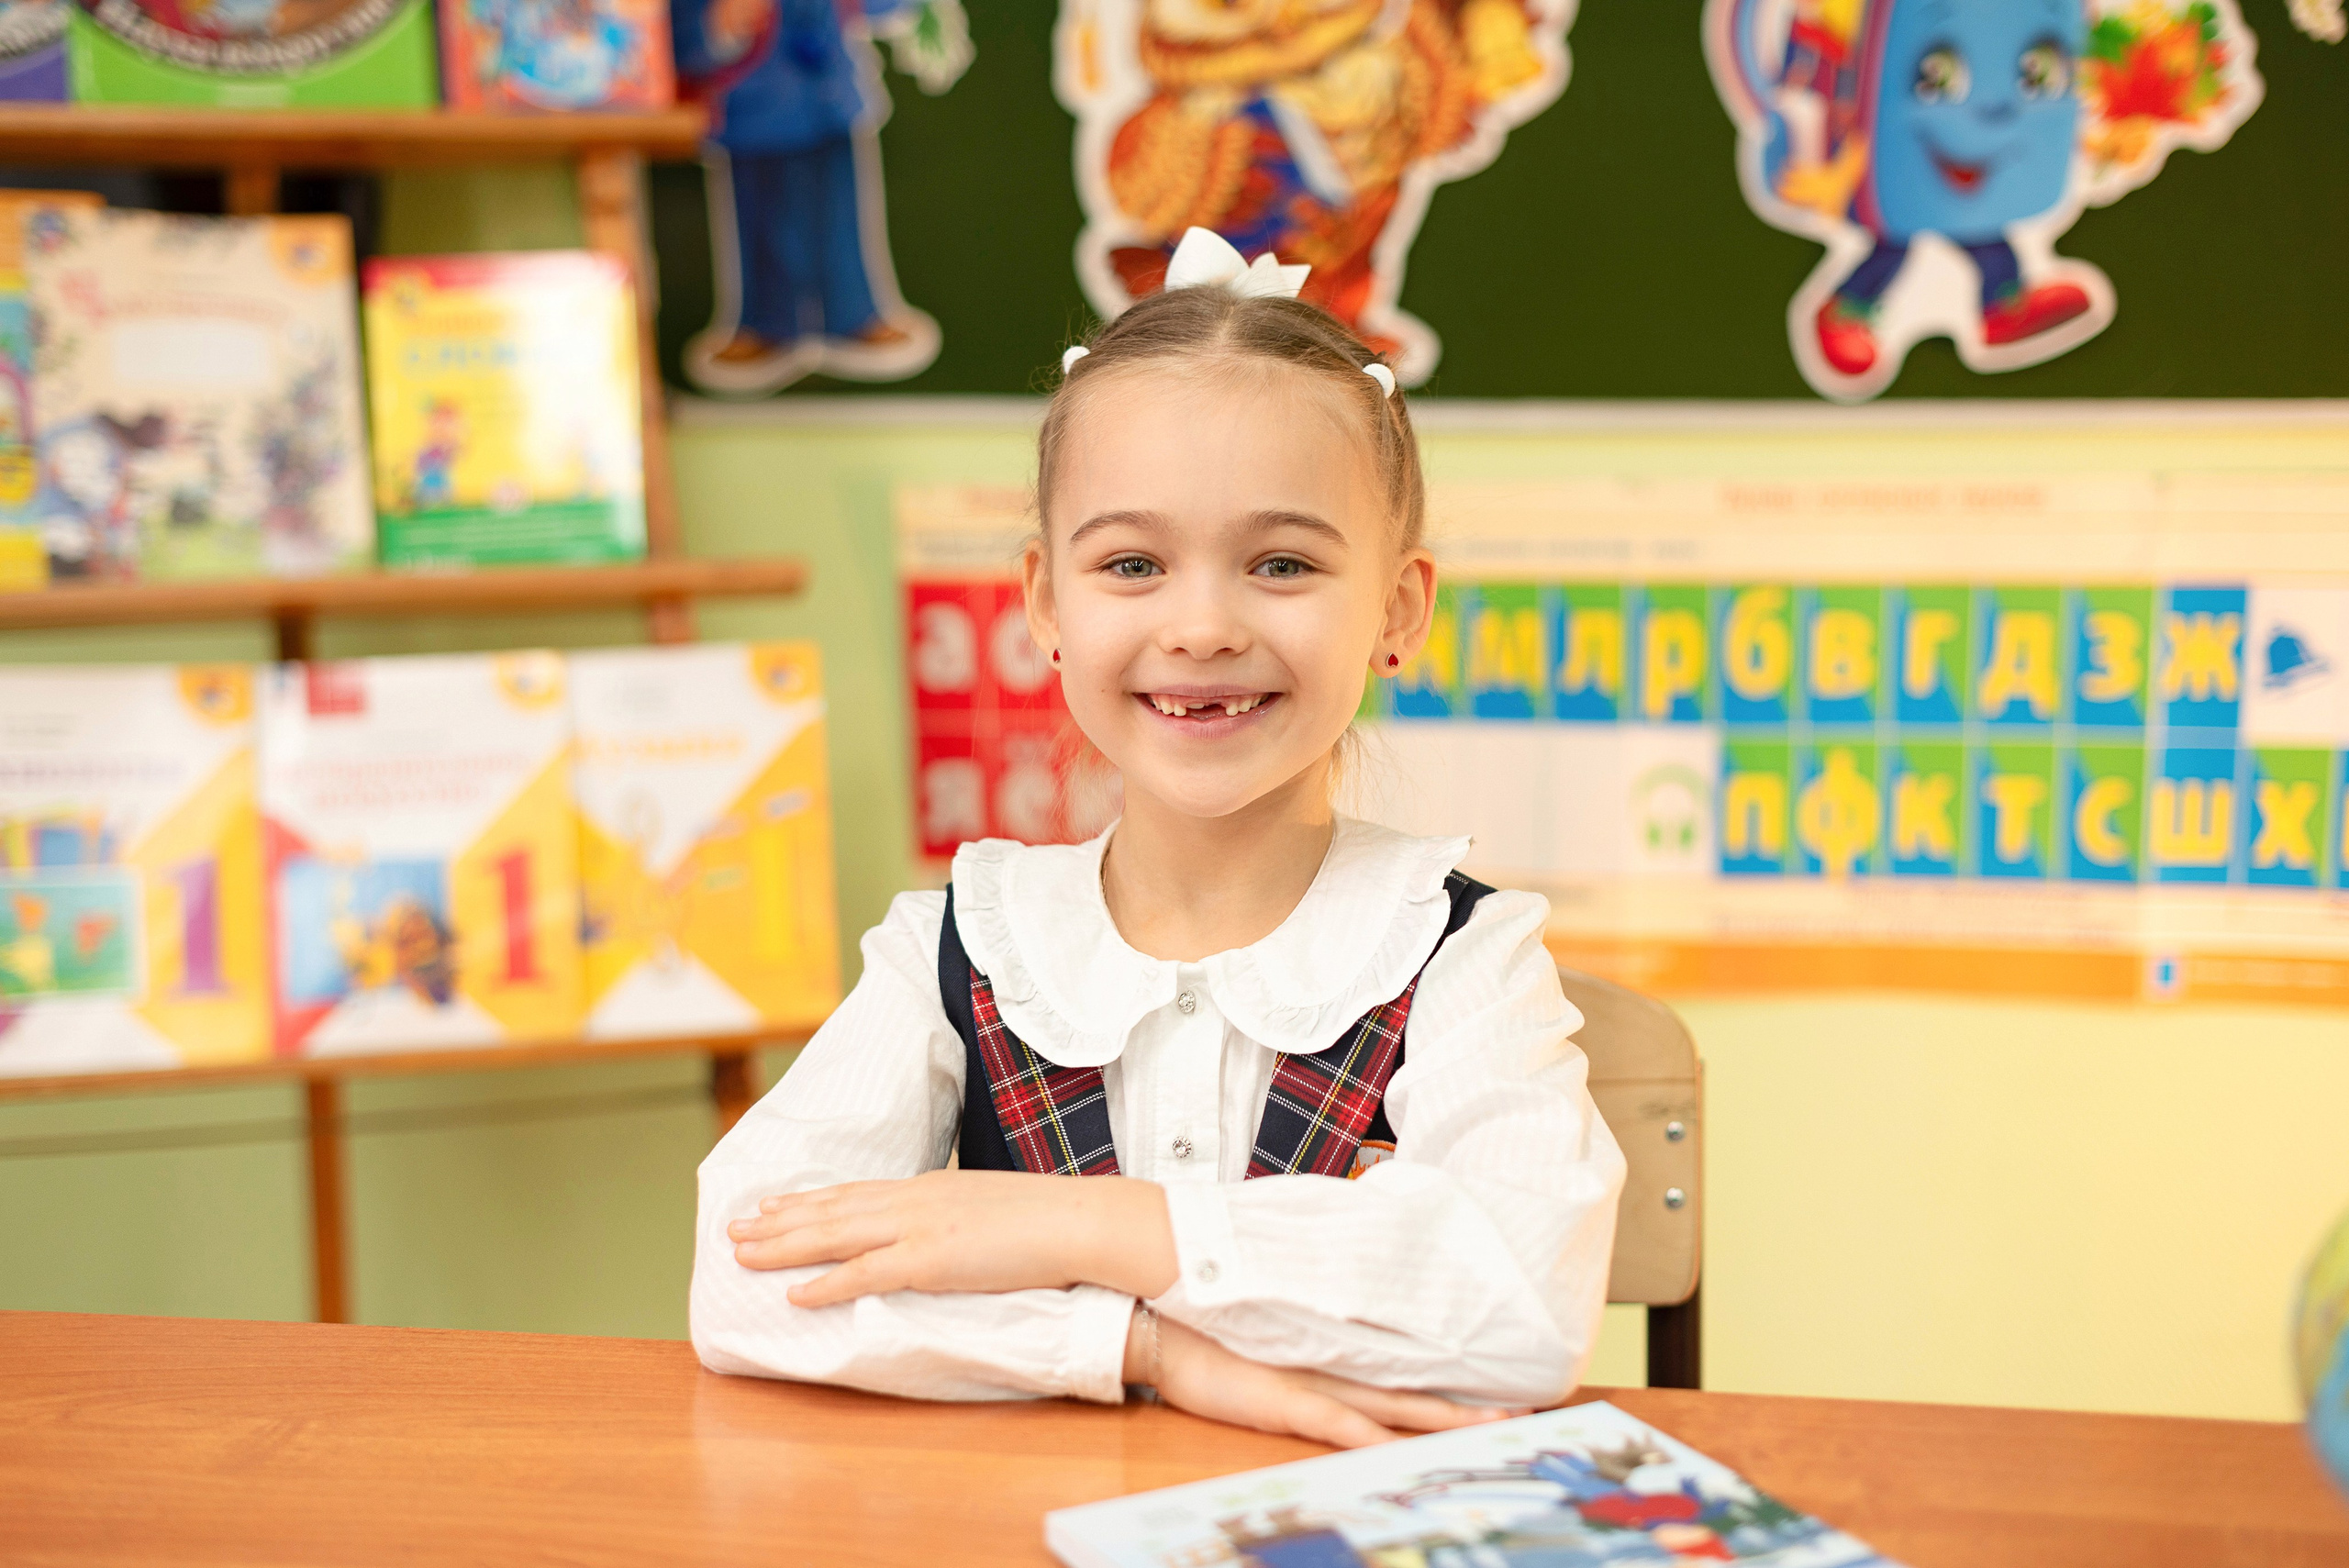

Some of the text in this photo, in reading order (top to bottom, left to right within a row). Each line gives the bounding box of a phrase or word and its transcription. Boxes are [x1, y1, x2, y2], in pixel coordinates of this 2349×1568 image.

[916, 601, 977, 694] а
[1563, 610, 1624, 690] л
[1644, 610, 1707, 717] р
[1724, 585, 1792, 696] б
[1810, 610, 1879, 695] в
[1907, 610, 1960, 695] г
[1978, 610, 2061, 717] д
[2081, 611, 2144, 699] з
[2160, 611, 2241, 701] ж
[1723, 773, 1787, 855] п
[1796, 747, 1880, 883] ф
[1892, 773, 1956, 855] к
[1982, 774, 2048, 861] т
[2076, 777, 2133, 864] с
[2149, 778, 2236, 866] ш
[2253, 780, 2319, 868] х
[163, 856, 240, 1002] 1
[484, 848, 554, 990] 1
